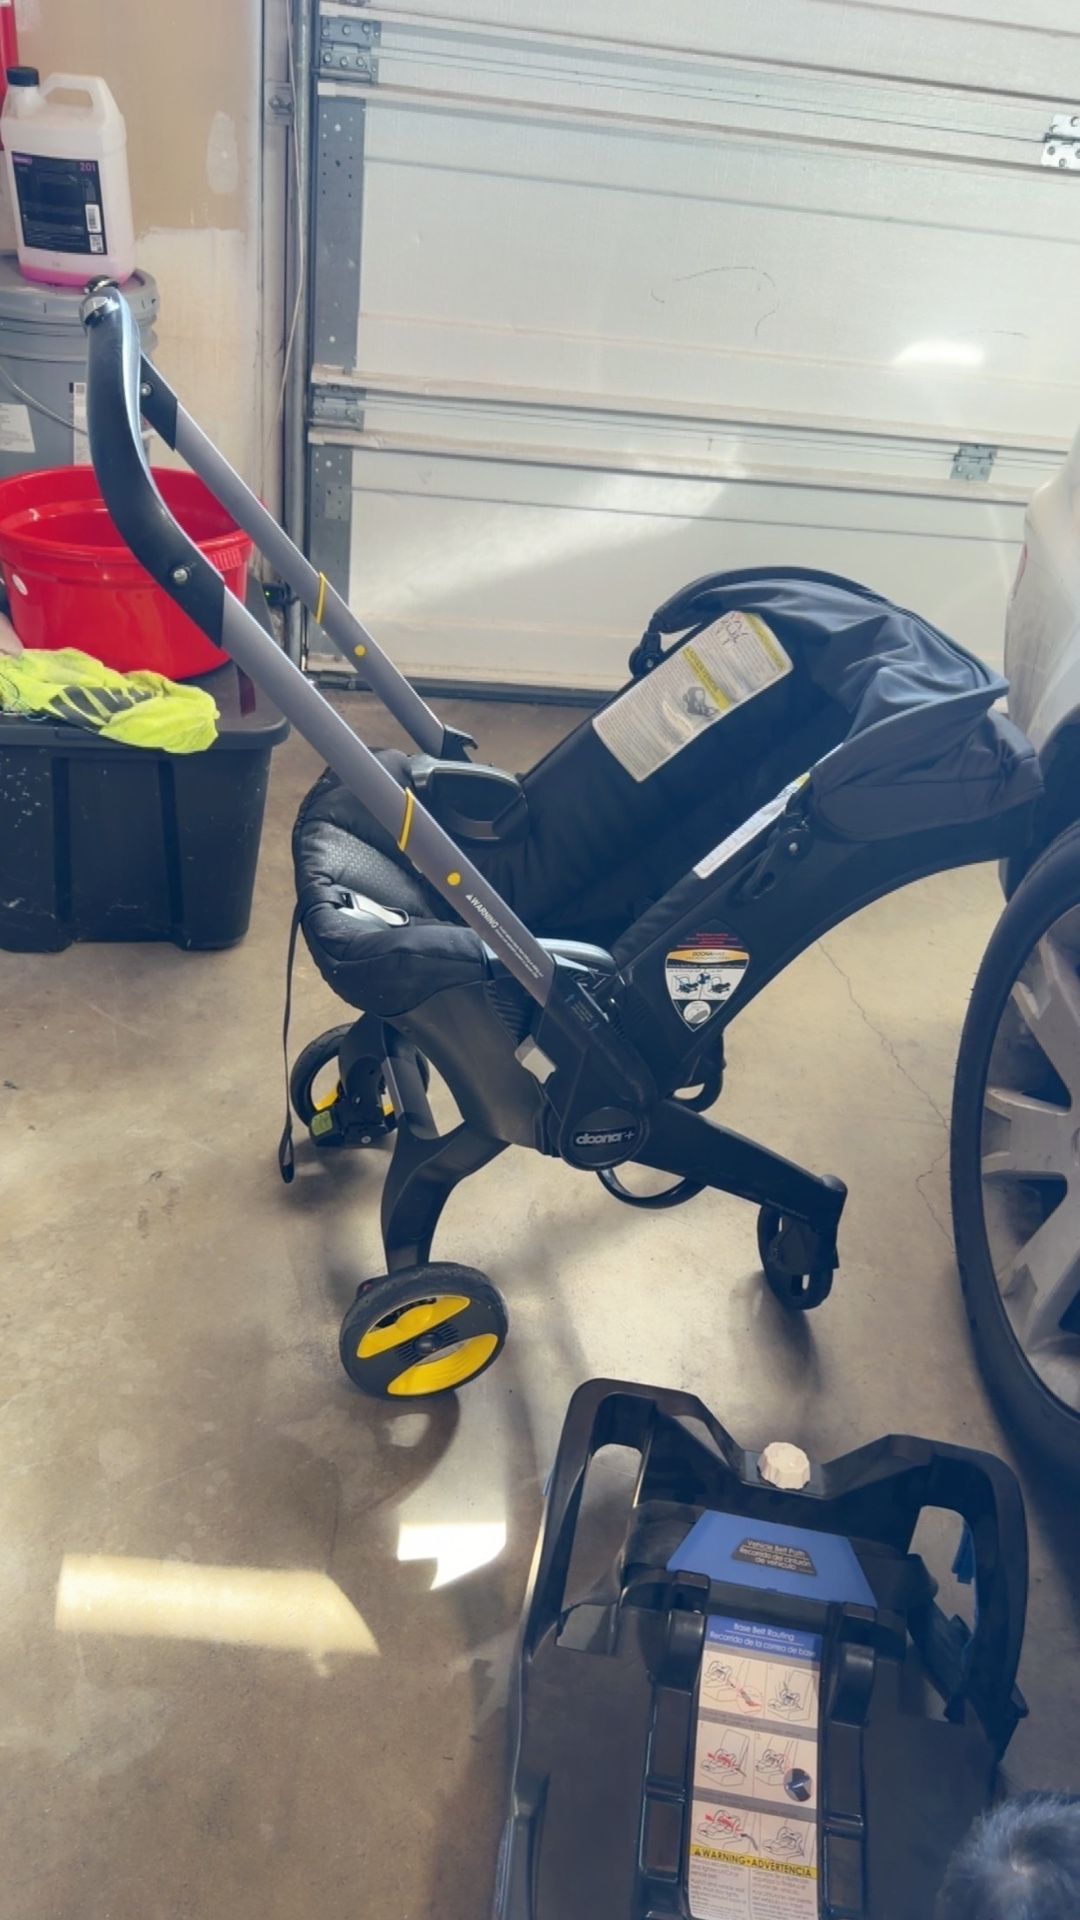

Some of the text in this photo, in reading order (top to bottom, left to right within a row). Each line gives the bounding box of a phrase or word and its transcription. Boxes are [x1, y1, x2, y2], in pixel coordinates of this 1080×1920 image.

[471, 897, 499, 929] WARNING
[709, 1630, 742, 1644] Recorrido
[743, 1636, 754, 1646] de
[787, 1645, 797, 1654] de
[733, 1622, 795, 1641] Base Belt Routing
